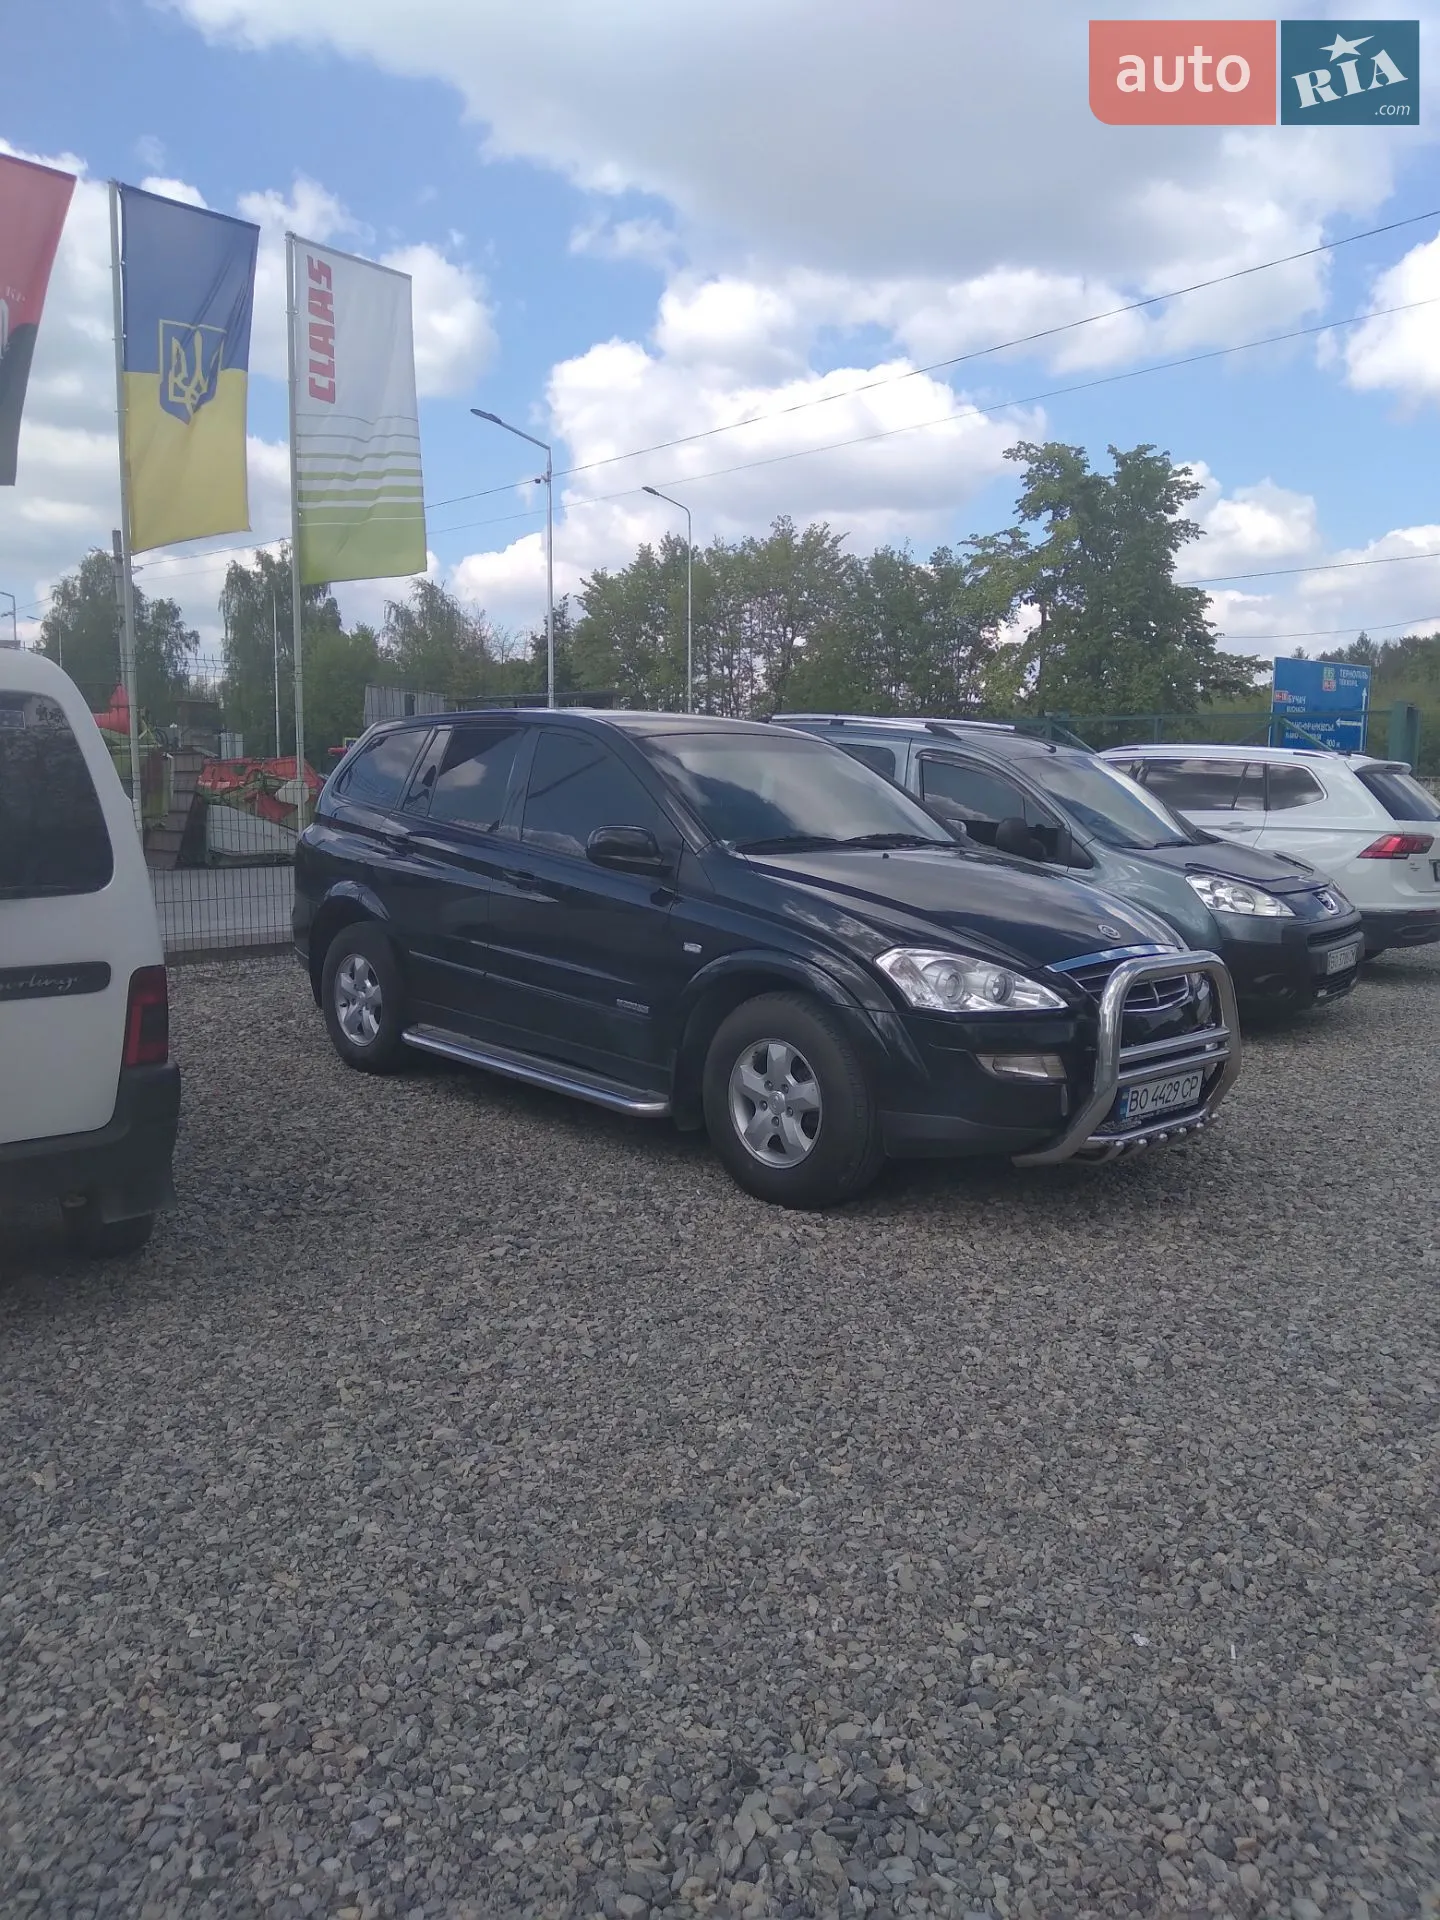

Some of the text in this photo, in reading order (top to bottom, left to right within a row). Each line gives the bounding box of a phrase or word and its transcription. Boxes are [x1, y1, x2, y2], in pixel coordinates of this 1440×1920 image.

[306, 254, 336, 404] CLAAS
[1129, 1076, 1199, 1112] BO 4429 CP
